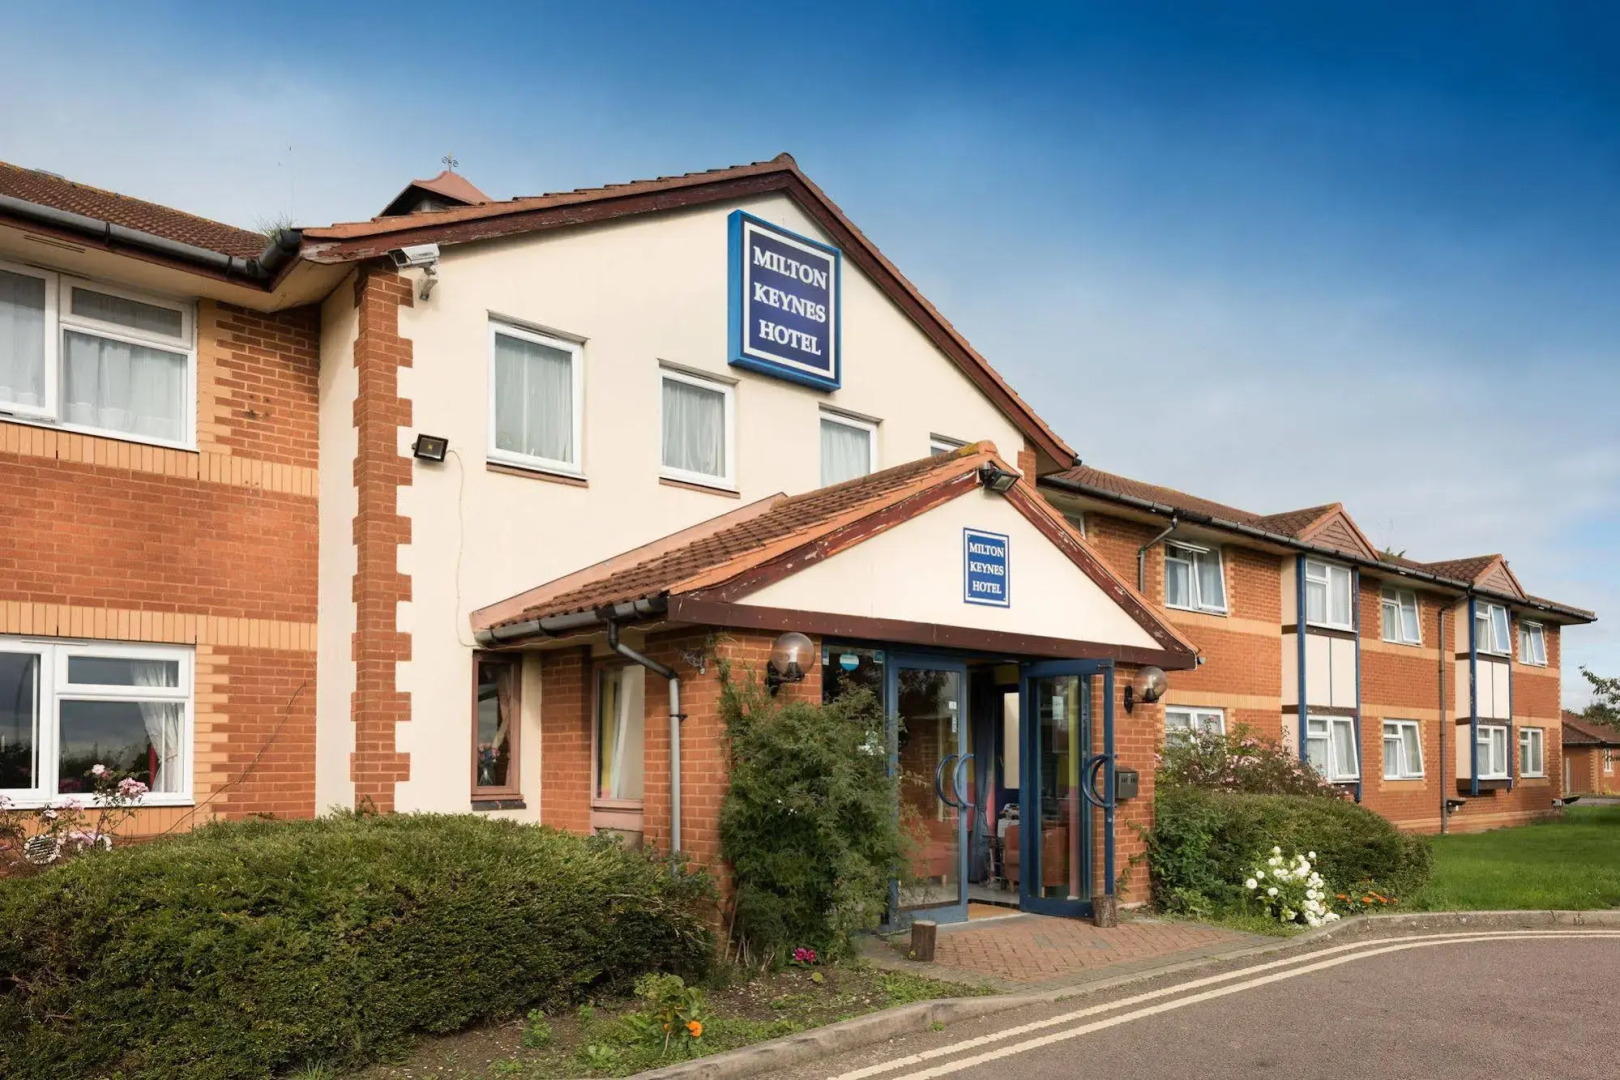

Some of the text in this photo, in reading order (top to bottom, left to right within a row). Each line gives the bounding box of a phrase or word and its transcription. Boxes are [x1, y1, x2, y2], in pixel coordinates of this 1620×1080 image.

[753, 246, 827, 290] MILTON
[754, 281, 826, 323] KEYNES
[759, 319, 821, 355] HOTEL
[969, 543, 1004, 557] MILTON
[970, 561, 1004, 576] KEYNES
[972, 581, 1002, 593] HOTEL
